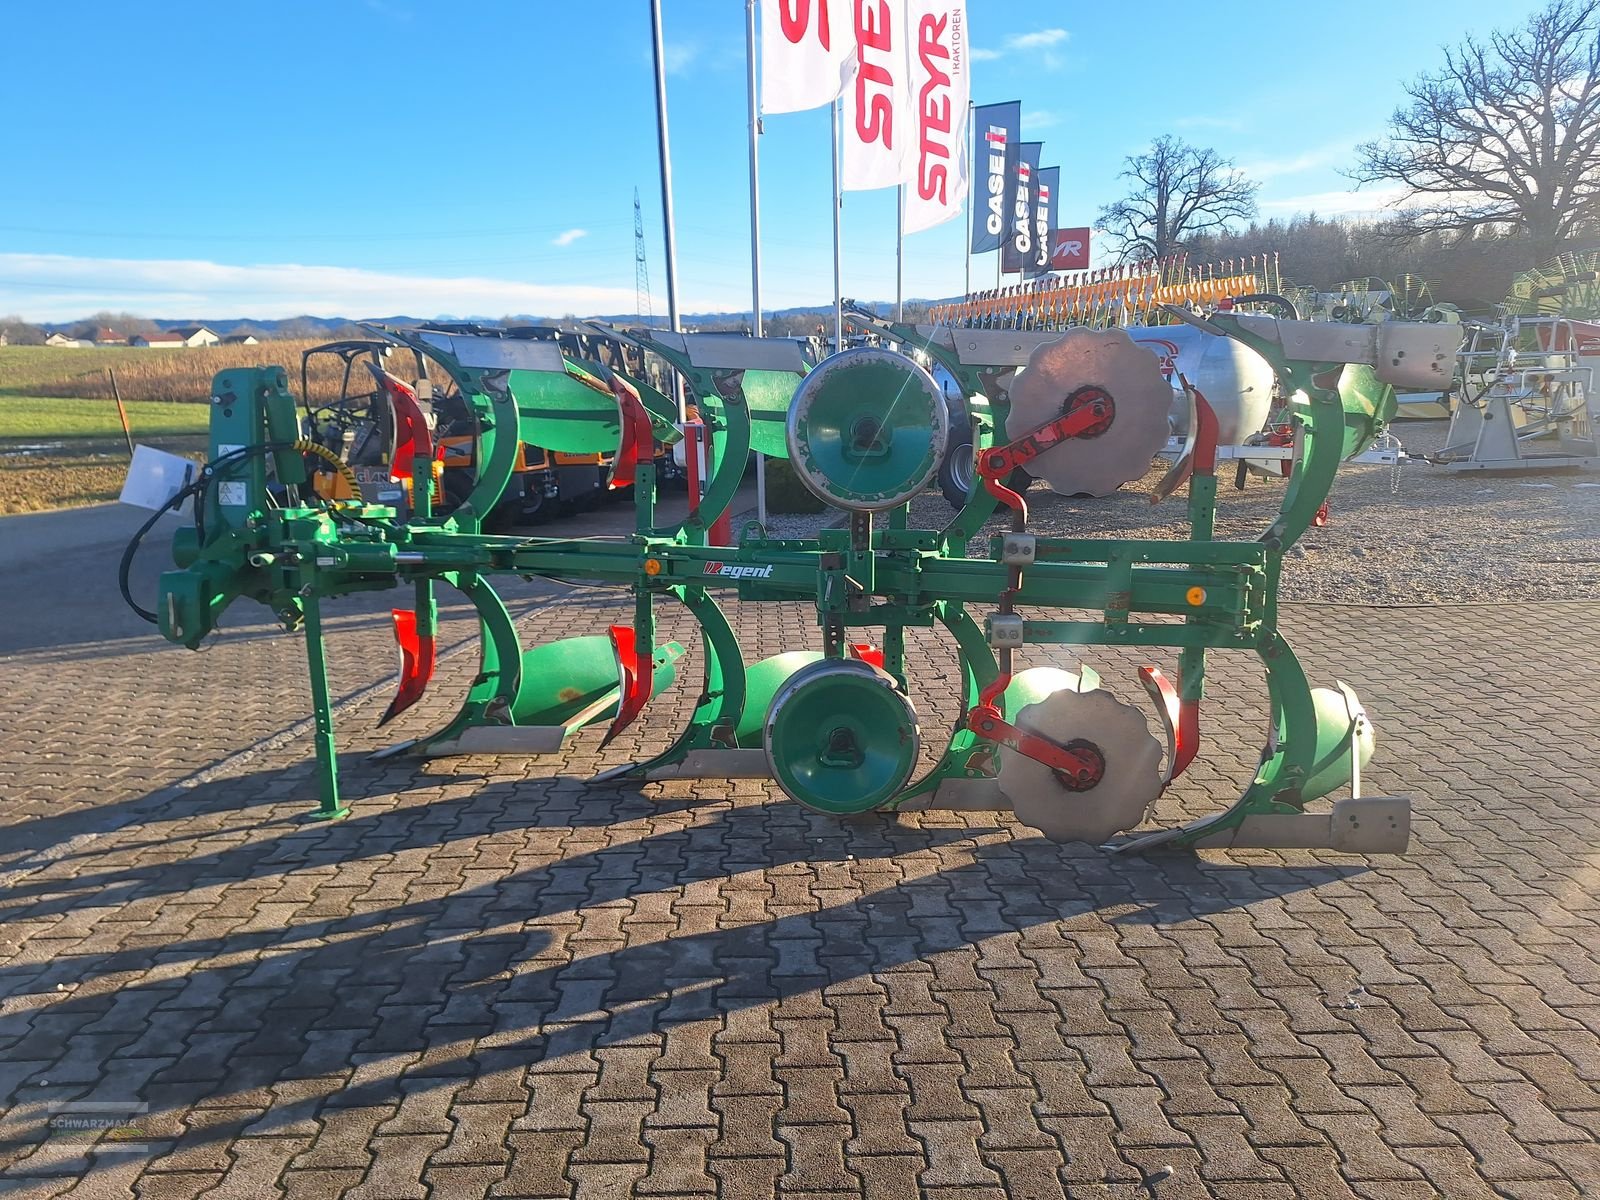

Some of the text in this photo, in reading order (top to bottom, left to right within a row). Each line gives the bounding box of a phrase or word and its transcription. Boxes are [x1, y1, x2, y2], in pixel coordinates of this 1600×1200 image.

[952, 8, 961, 75] TRAKTOREN
[918, 12, 950, 206] STEYR
[987, 154, 1005, 235] CASE
[1015, 185, 1031, 253] CASE
[1036, 206, 1048, 266] CASE
[703, 561, 774, 579] Regent
